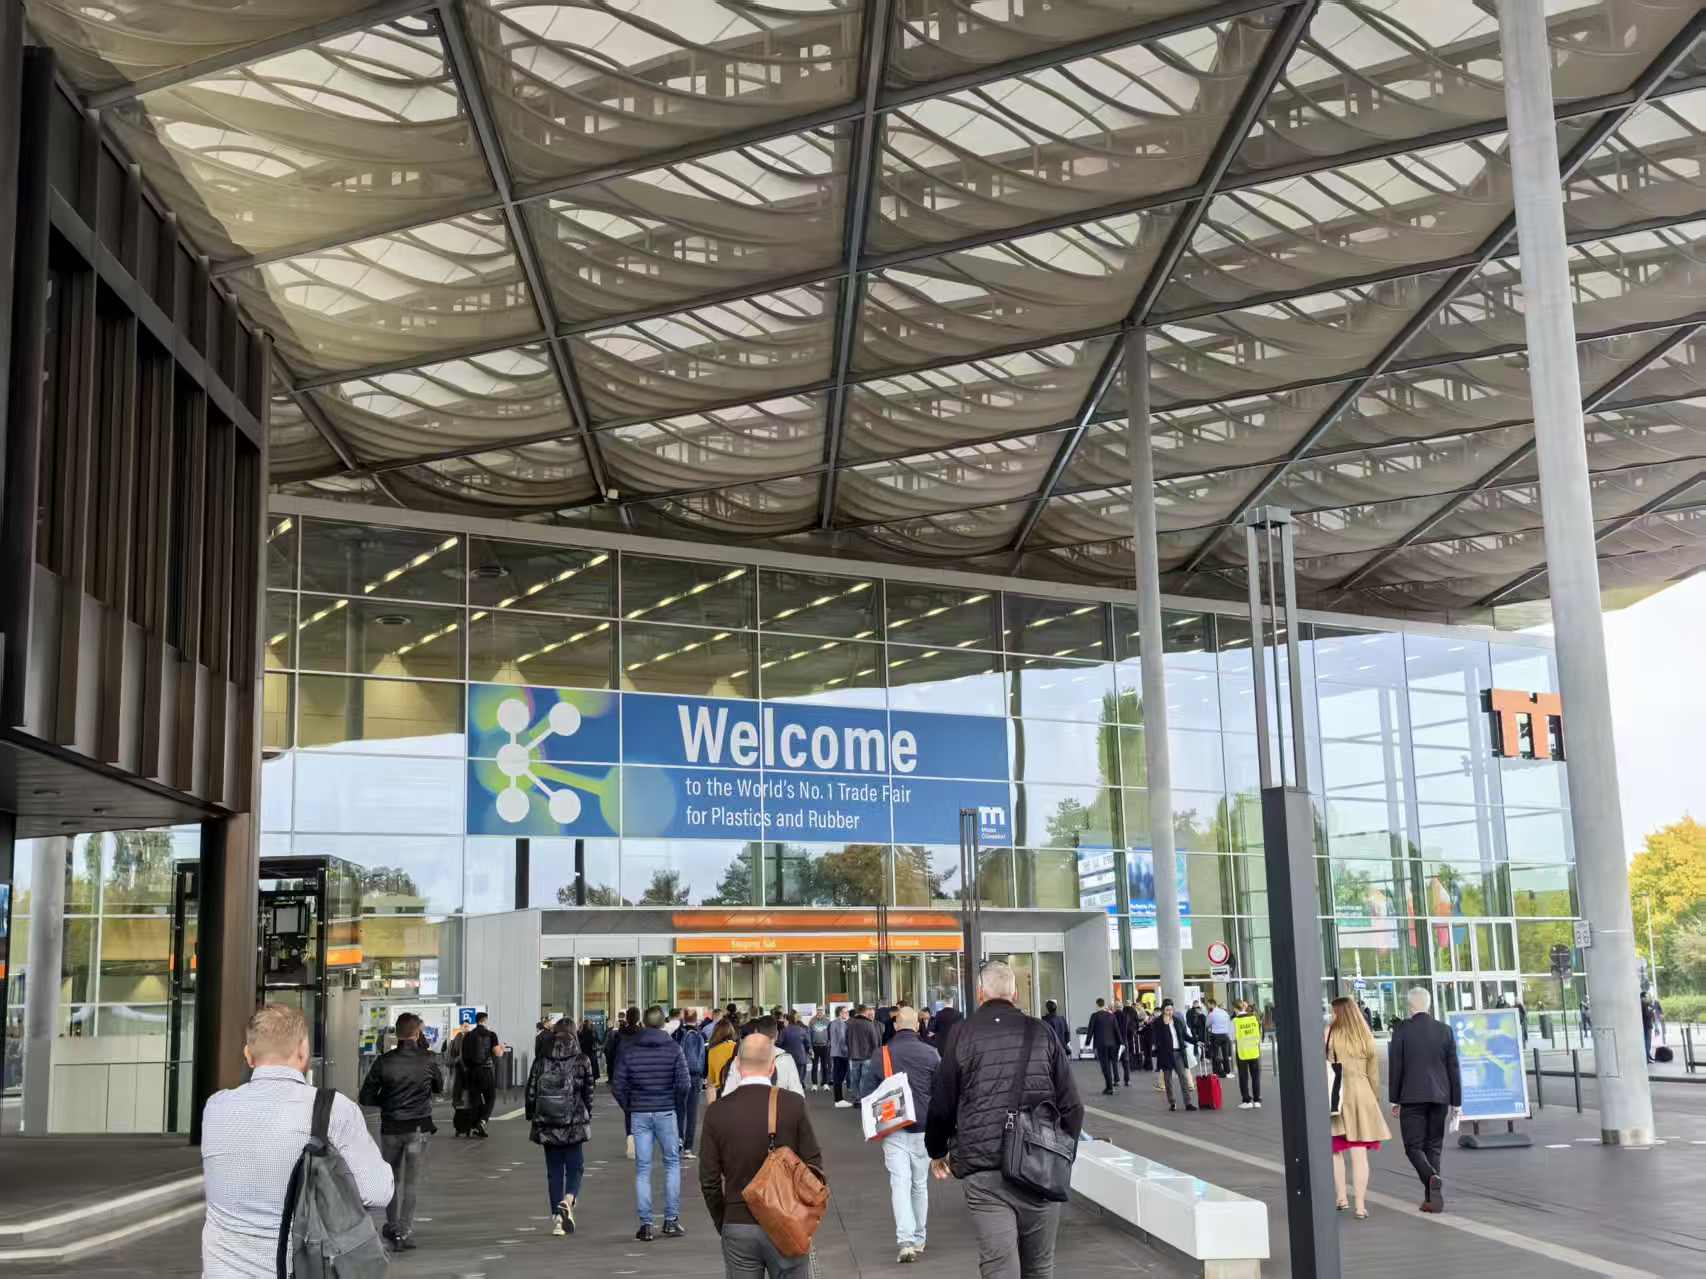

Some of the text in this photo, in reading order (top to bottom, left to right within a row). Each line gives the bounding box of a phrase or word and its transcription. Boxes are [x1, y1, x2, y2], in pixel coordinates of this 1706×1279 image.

[678, 704, 917, 773] Welcome
[685, 777, 701, 796] to
[706, 777, 732, 797] the
[799, 781, 824, 801] No.
[838, 783, 878, 801] Trade
[882, 785, 912, 803] Fair
[686, 806, 860, 829] for Plastics and Rubber
